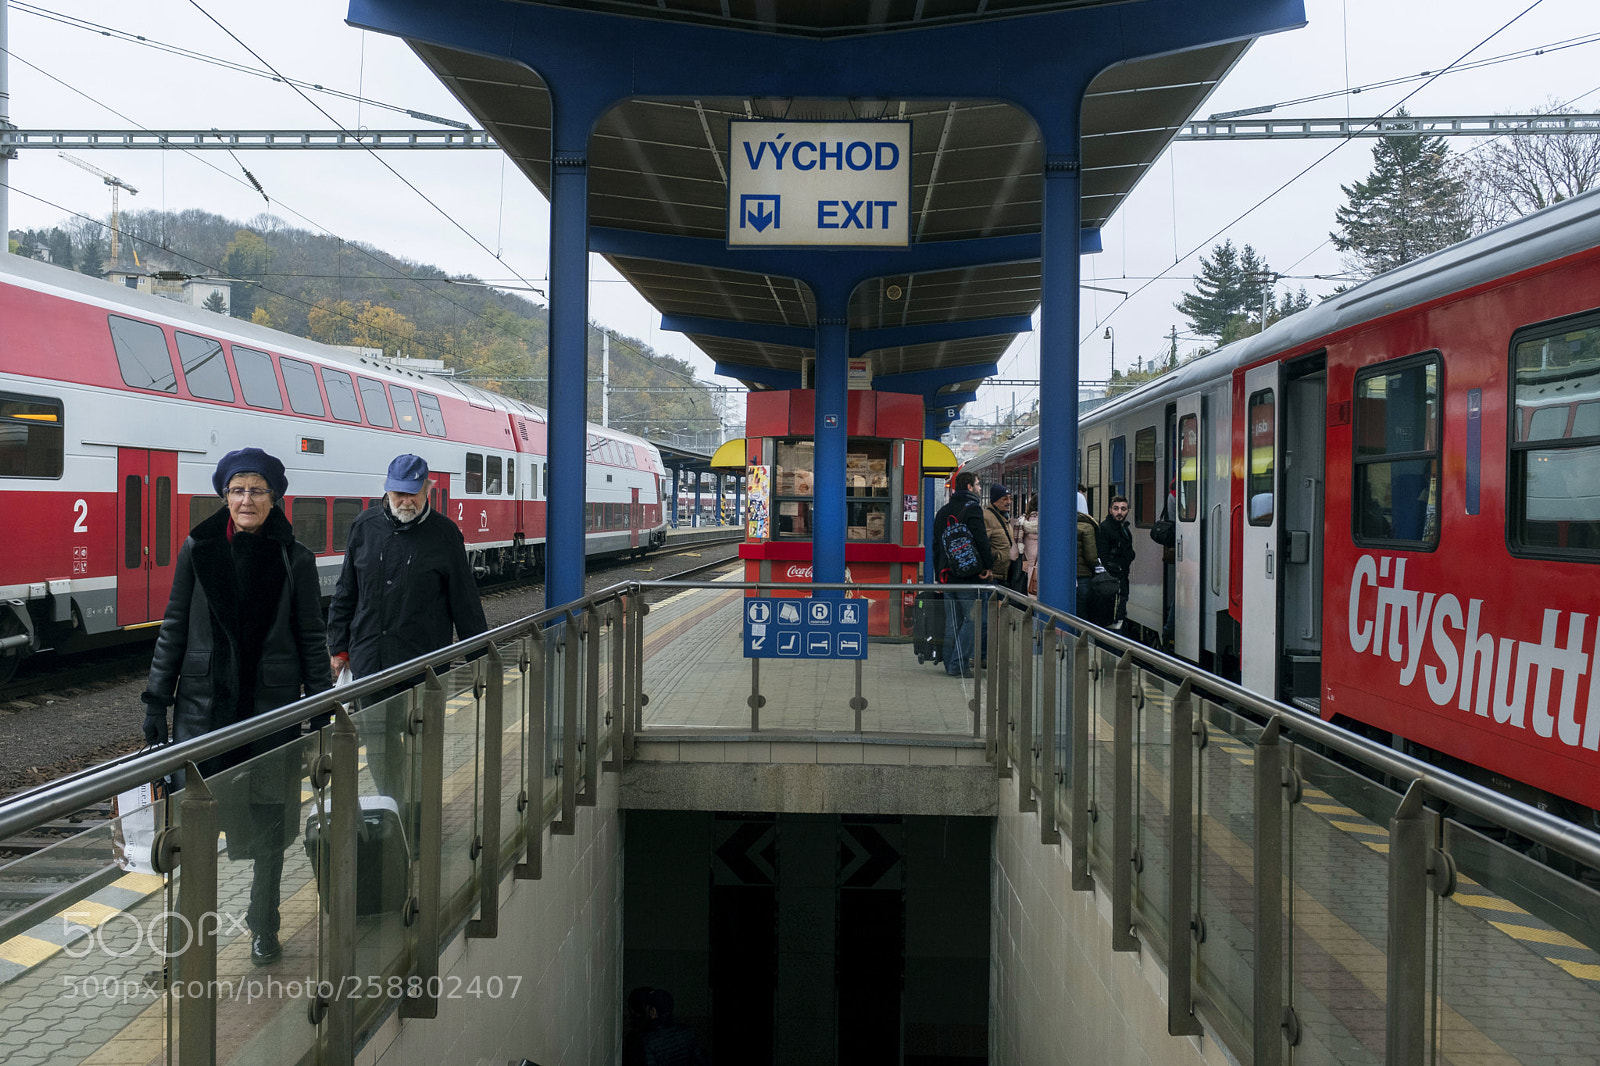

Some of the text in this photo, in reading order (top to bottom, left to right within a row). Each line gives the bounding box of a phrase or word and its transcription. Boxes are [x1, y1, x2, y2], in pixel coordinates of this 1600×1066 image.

[743, 133, 900, 171] VÝCHOD
[818, 200, 898, 229] EXIT
[947, 408, 956, 418] B
[73, 498, 88, 533] 2
[458, 502, 463, 521] 2
